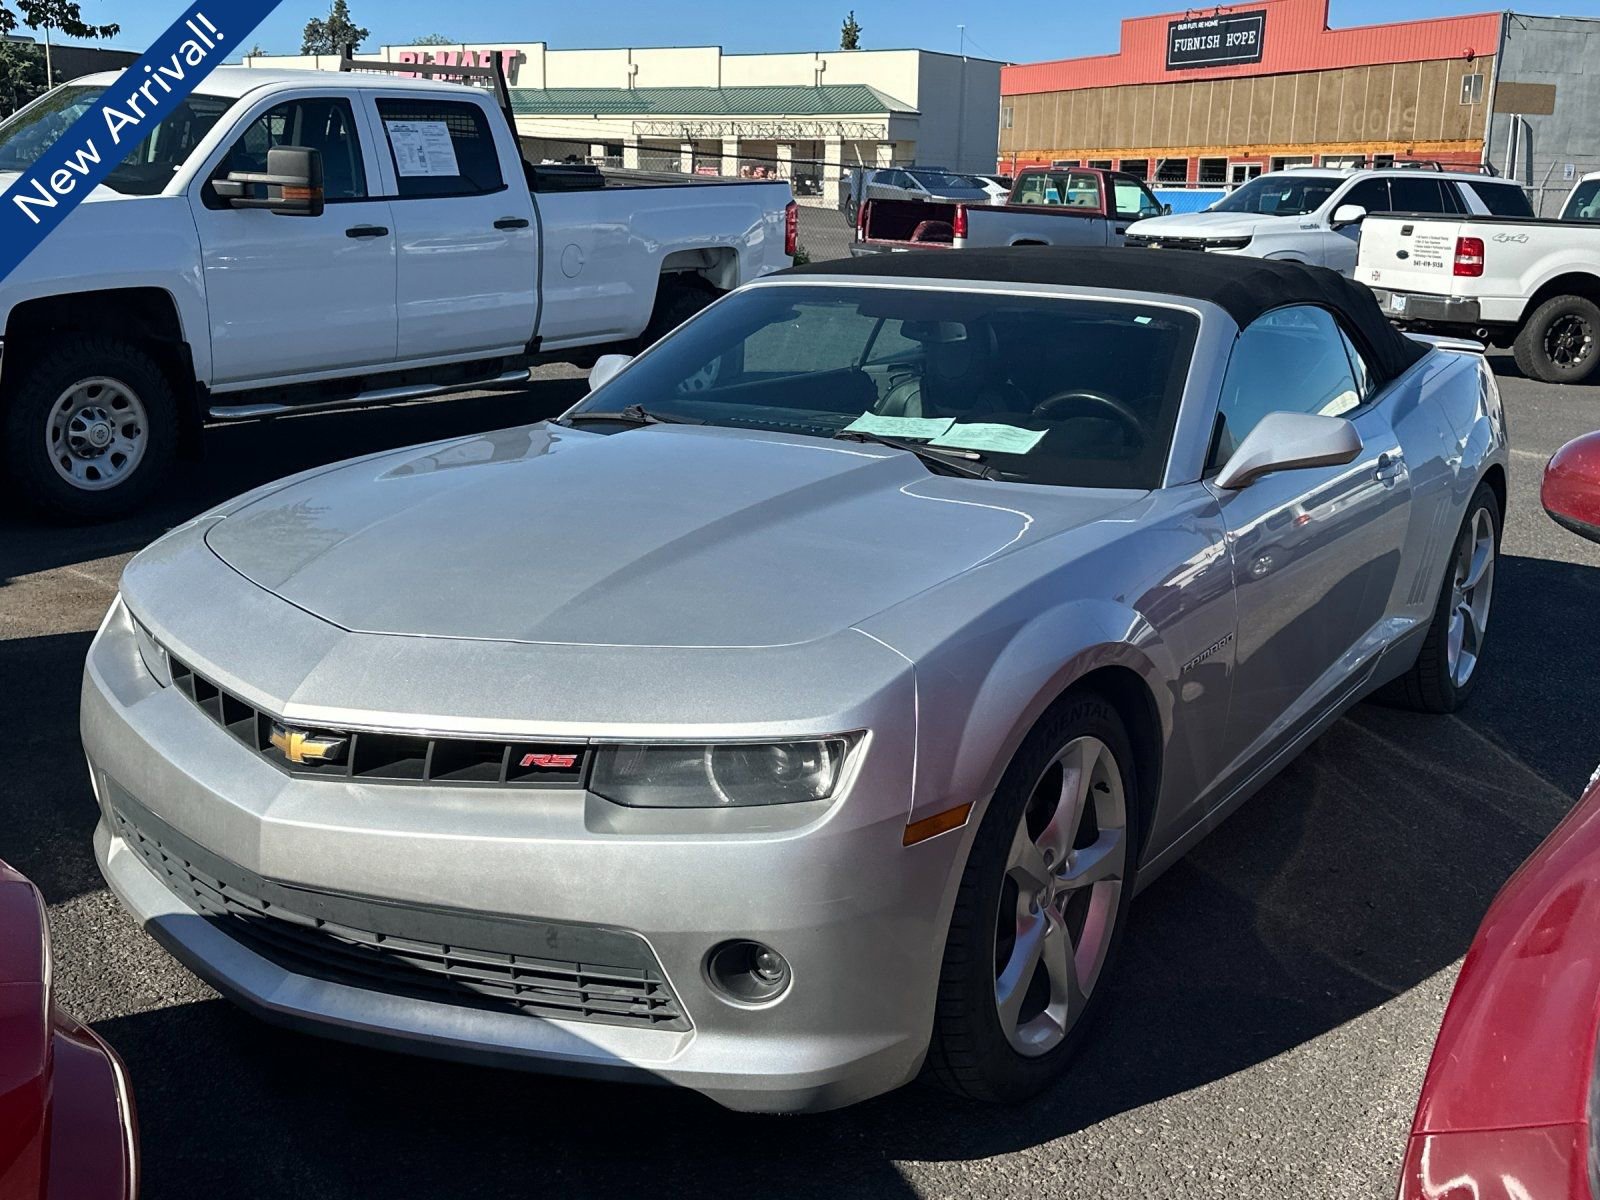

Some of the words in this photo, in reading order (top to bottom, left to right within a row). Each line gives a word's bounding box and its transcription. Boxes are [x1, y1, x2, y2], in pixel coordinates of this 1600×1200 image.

[1174, 35, 1220, 52] FURNISH
[1212, 106, 1315, 138] dscont
[519, 753, 578, 767] RS
